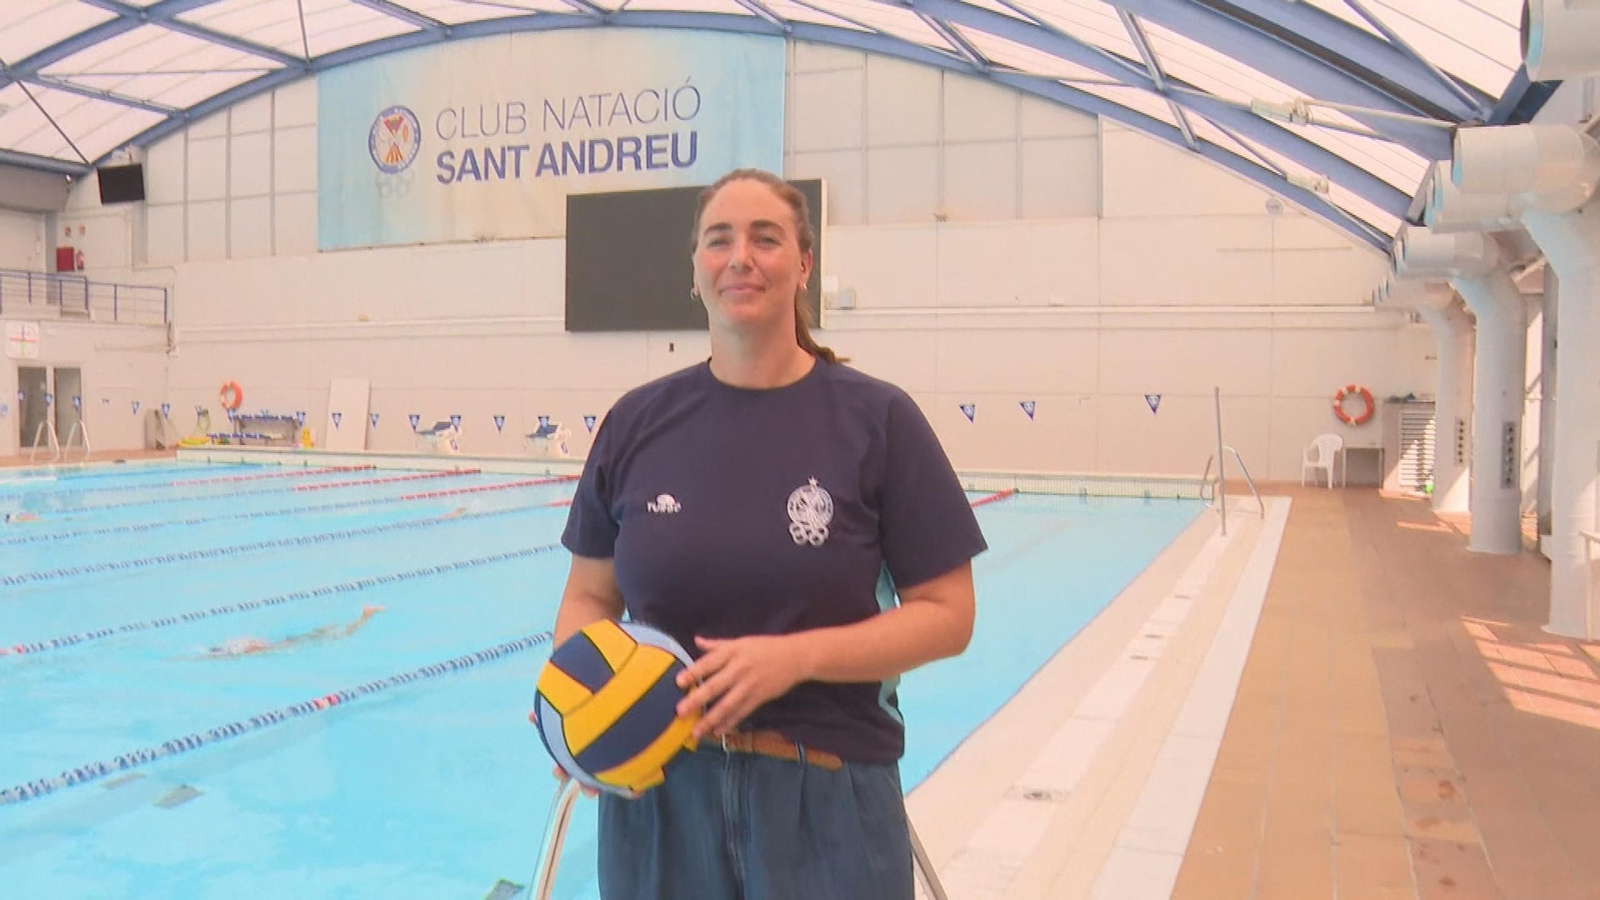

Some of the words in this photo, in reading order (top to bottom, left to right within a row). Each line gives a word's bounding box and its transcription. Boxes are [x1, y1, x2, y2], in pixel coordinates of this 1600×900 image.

[436, 102, 527, 140] CLUB
[543, 76, 701, 132] NATACIÓ
[436, 145, 530, 185] SANT
[536, 131, 698, 178] ANDREU
